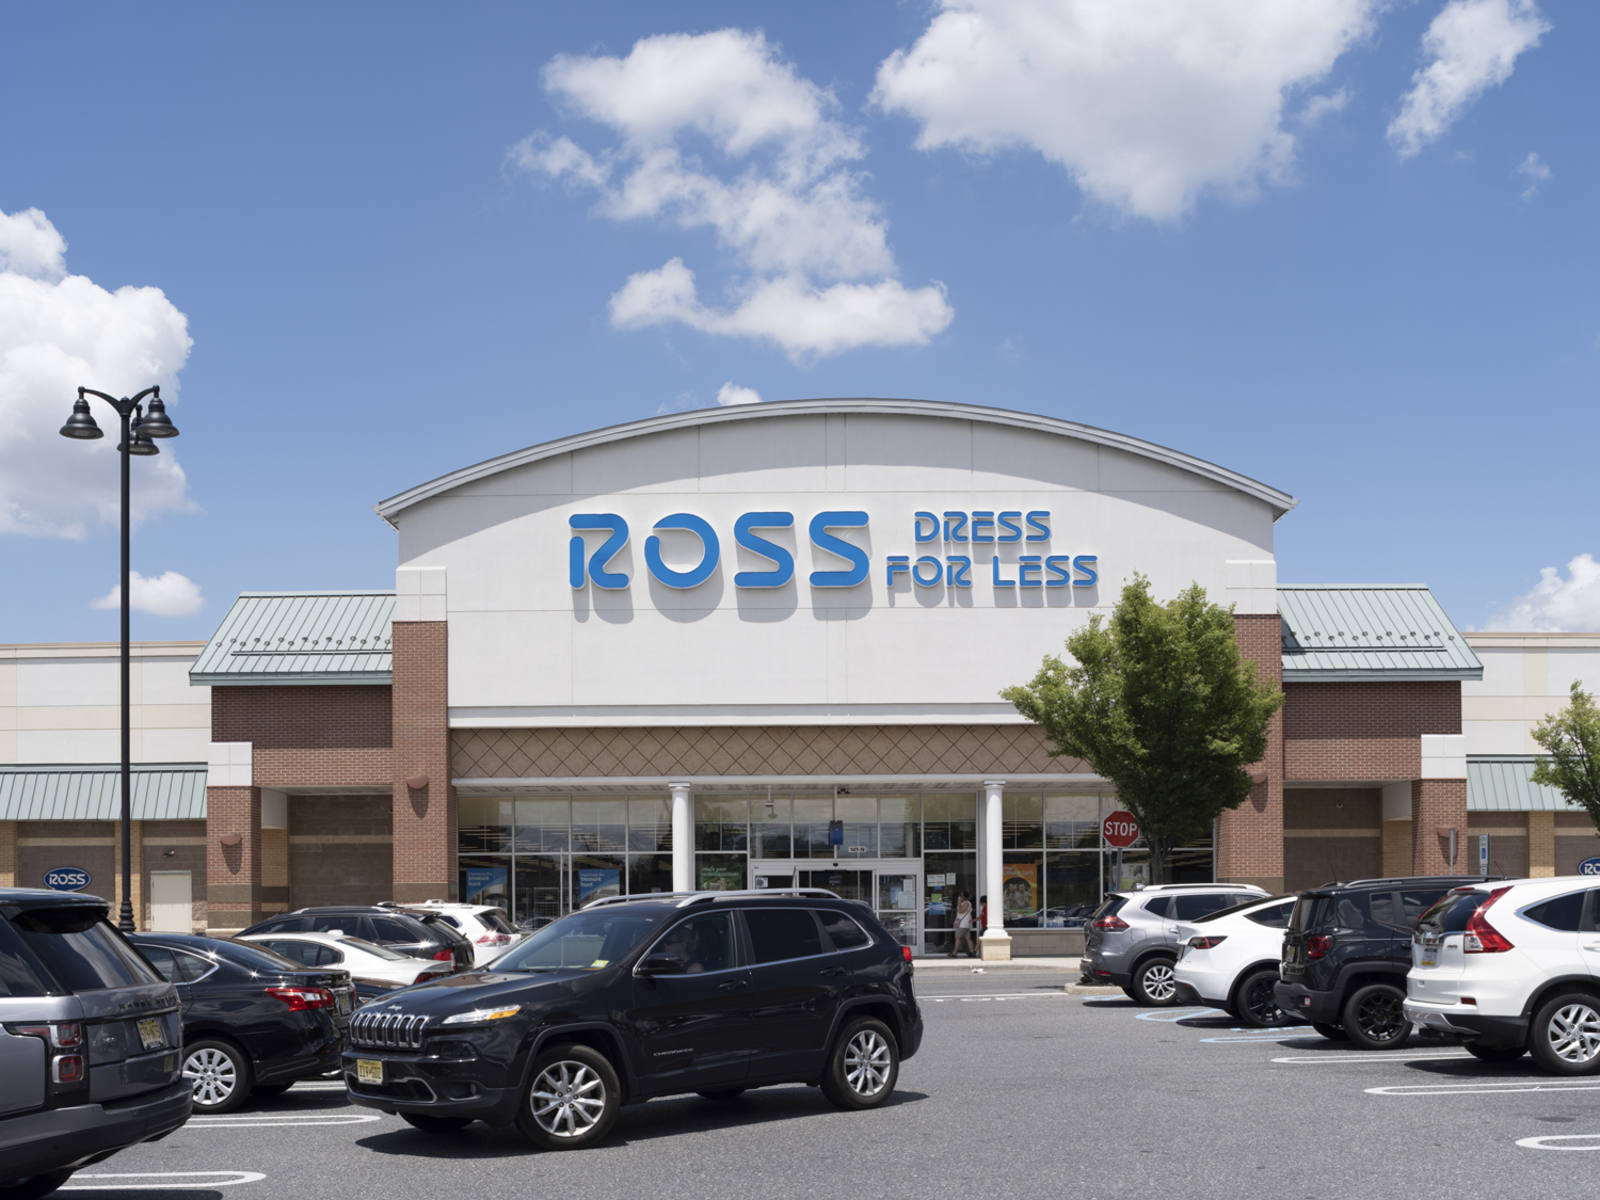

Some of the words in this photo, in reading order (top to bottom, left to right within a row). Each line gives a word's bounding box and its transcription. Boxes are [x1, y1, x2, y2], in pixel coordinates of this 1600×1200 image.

[915, 511, 1051, 542] DRESS
[569, 511, 870, 589] ROSS
[887, 555, 972, 587] FOR
[993, 555, 1098, 587] LESS
[1104, 821, 1138, 837] STOP
[48, 873, 87, 886] ROSS
